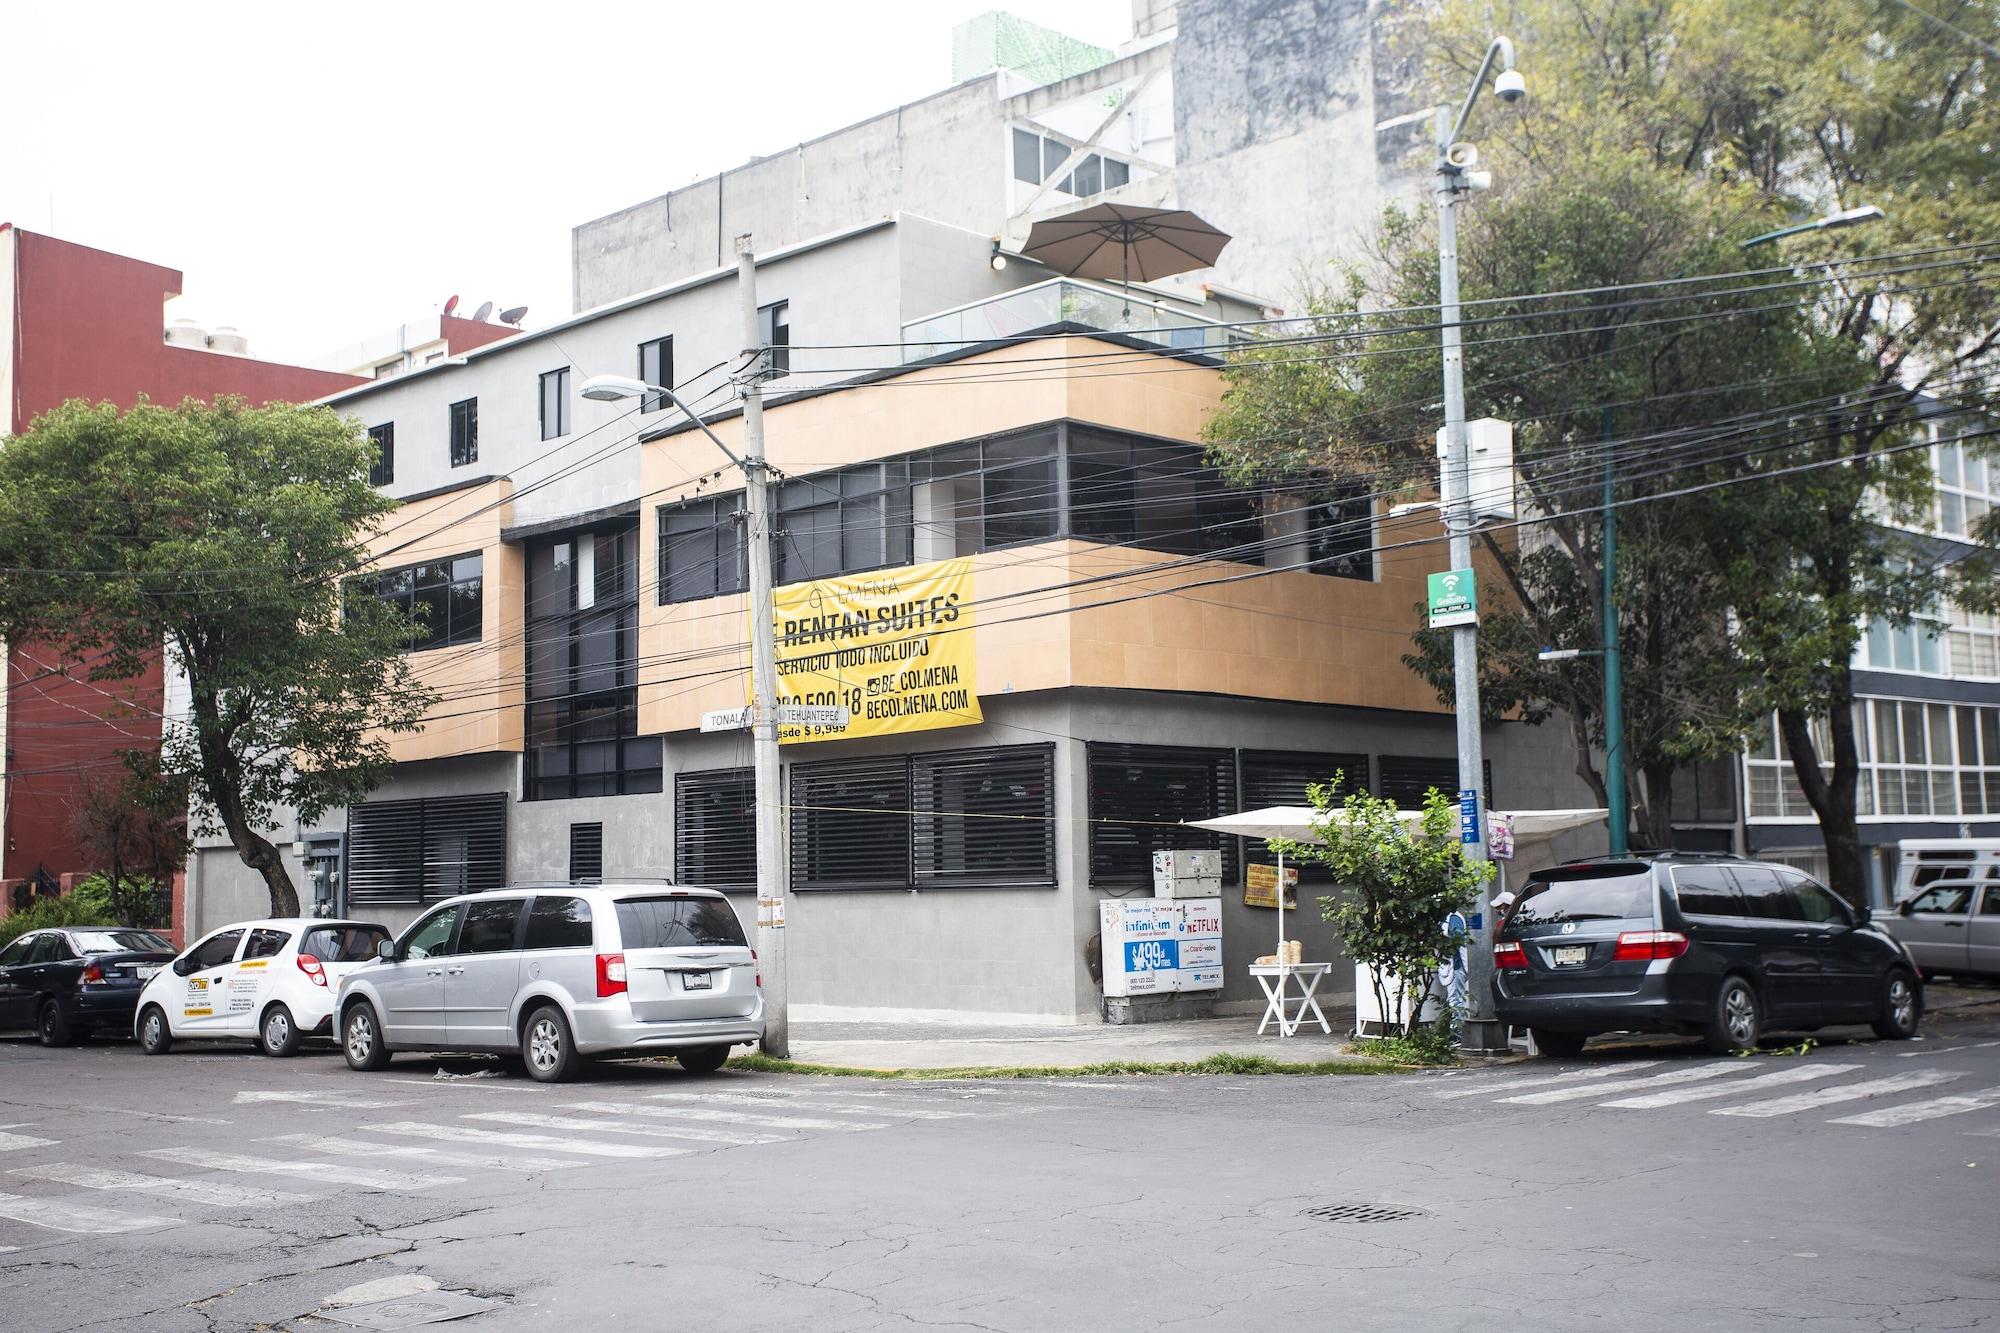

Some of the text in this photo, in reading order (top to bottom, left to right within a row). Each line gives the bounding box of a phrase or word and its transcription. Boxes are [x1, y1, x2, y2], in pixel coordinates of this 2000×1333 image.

[784, 592, 960, 648] RENTAN SUITES
[777, 637, 930, 676] SERVICIO TODO INCLUIDO
[881, 664, 959, 695] BE_COLMENA
[787, 708, 840, 722] TEHUANTEPEC
[867, 689, 969, 720] BECOLMENA.COM
[1187, 918, 1219, 934] NETFLIX
